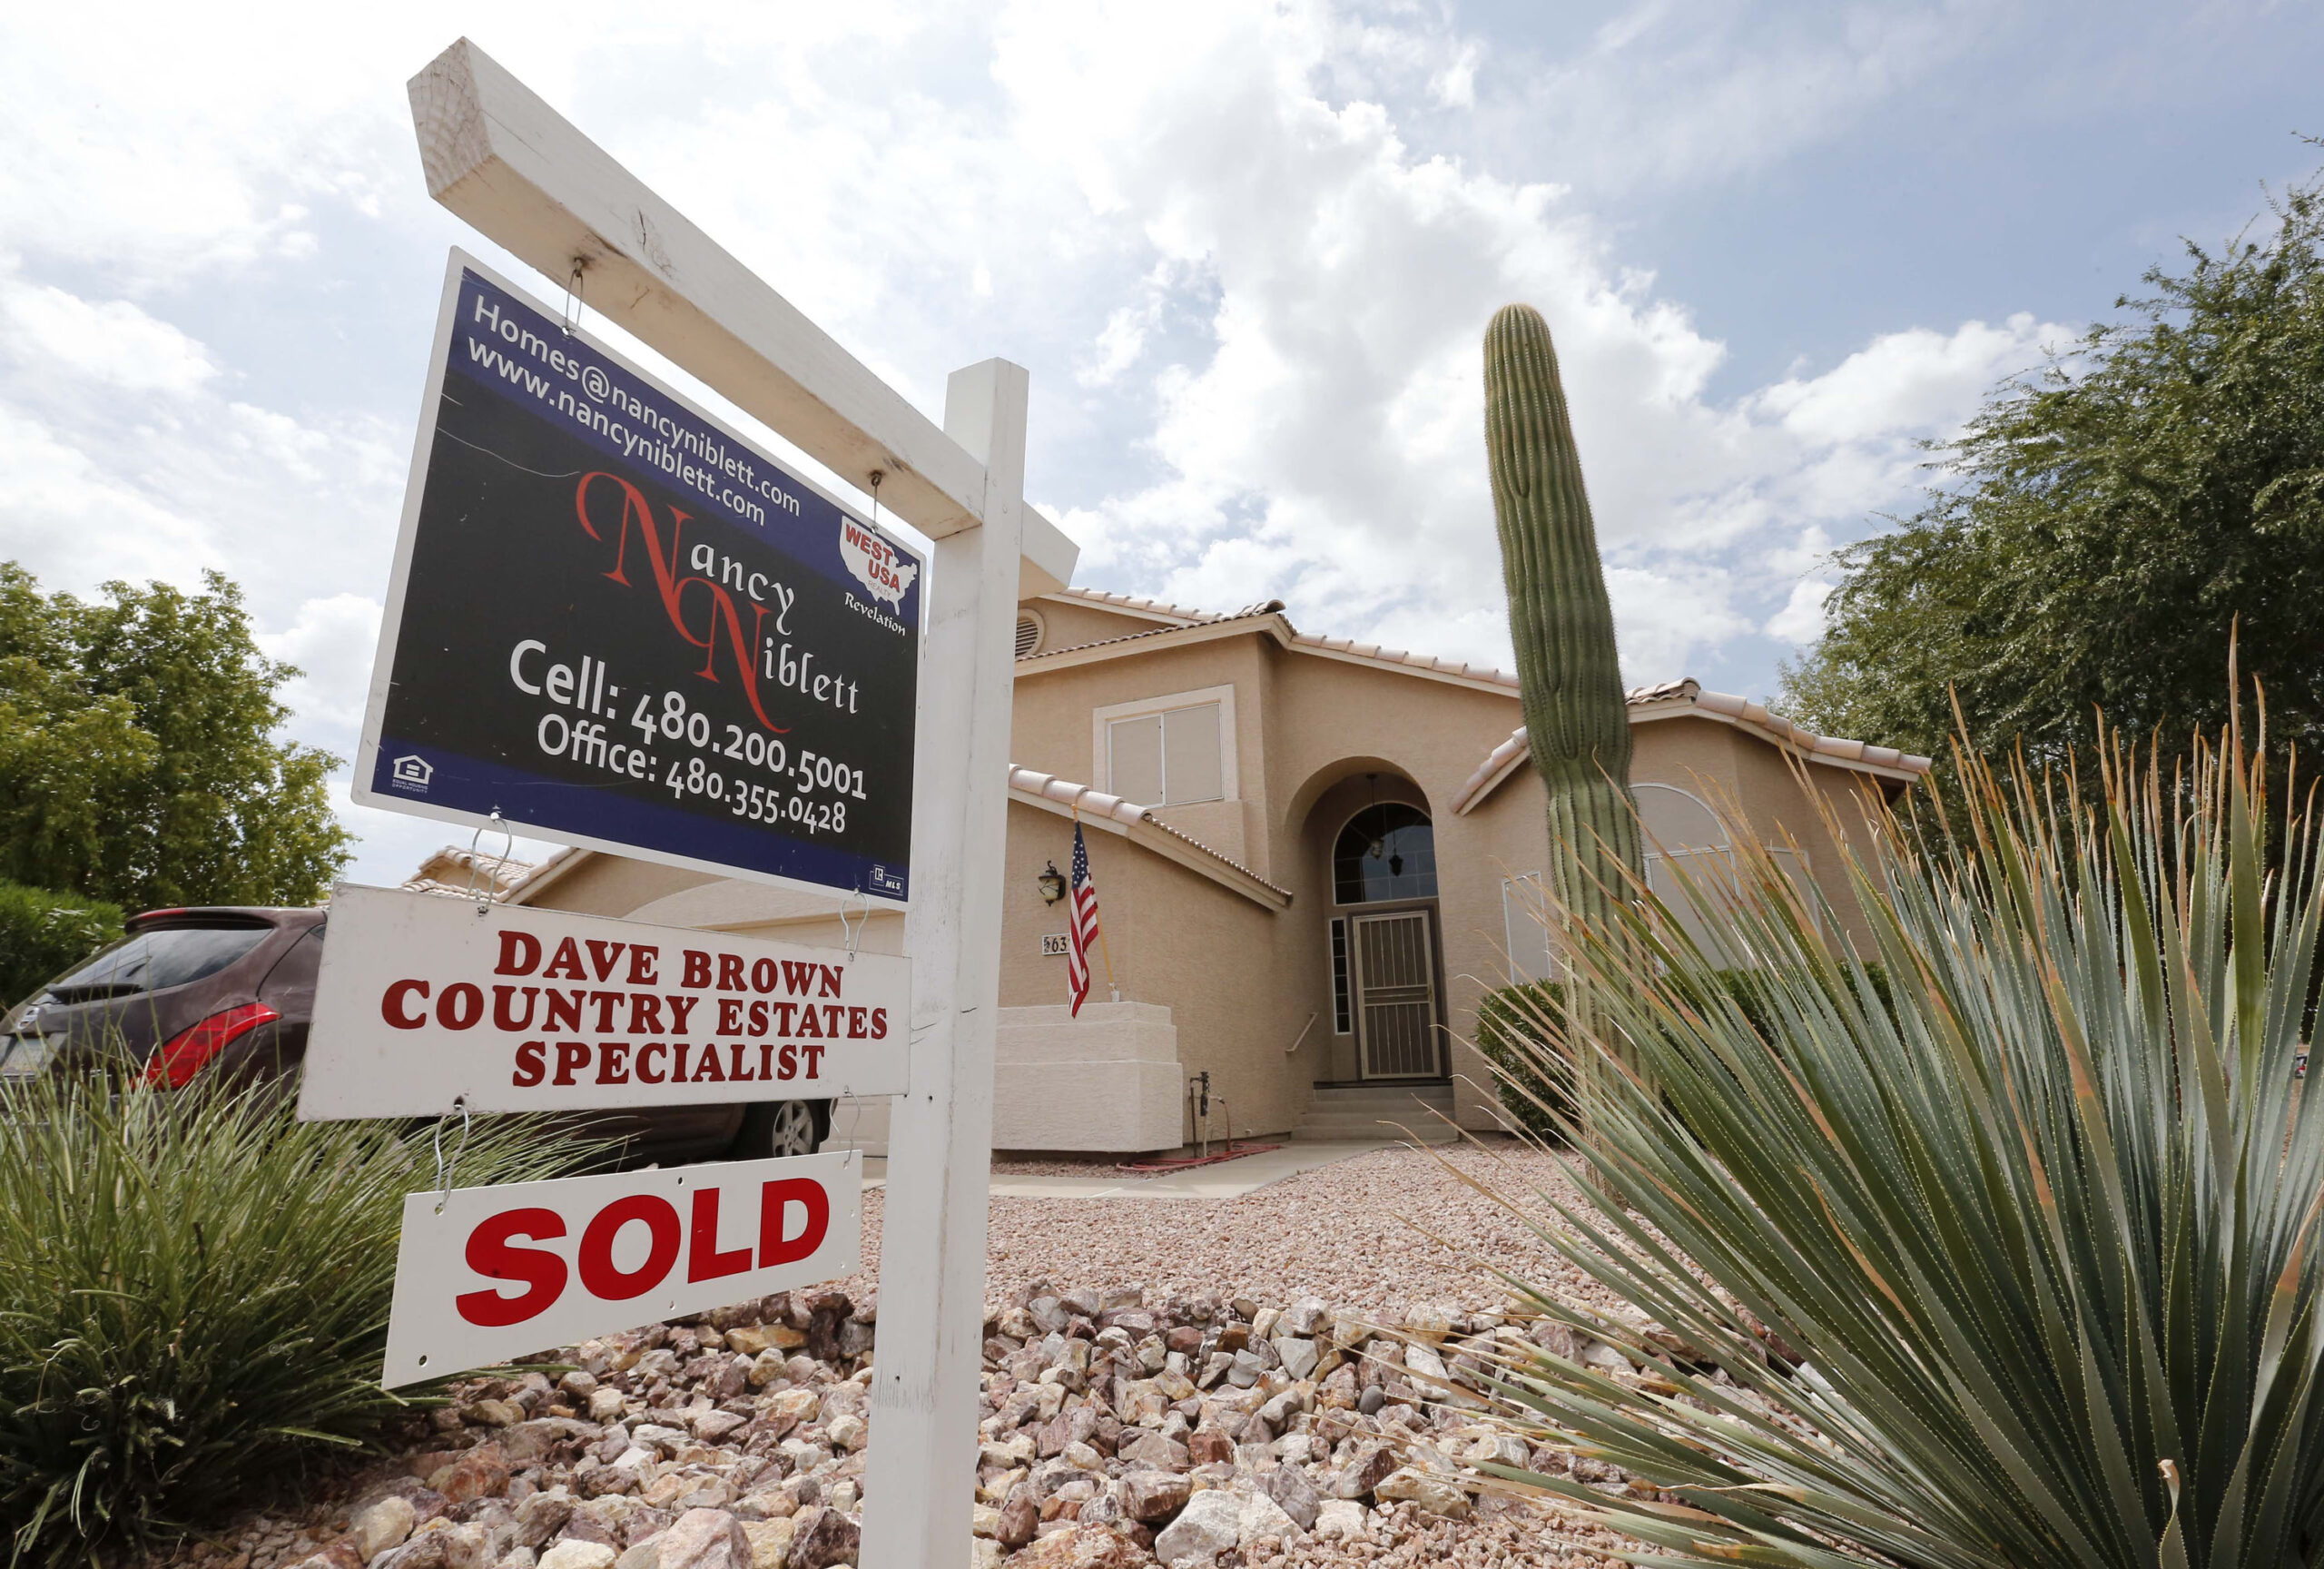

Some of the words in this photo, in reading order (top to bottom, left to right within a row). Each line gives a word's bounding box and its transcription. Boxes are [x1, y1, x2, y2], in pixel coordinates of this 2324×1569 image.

[468, 336, 765, 527] www.nancyniblett.com
[473, 294, 800, 517] Homes@nancyniblett.com
[576, 471, 795, 647] Nancy
[845, 523, 894, 567] WEST
[868, 558, 901, 593] USA
[844, 592, 906, 636] Revelation
[867, 580, 891, 597] REALTY
[673, 577, 860, 734] Niblett
[509, 638, 619, 720] Cell:
[631, 691, 867, 800] 480.200.5001
[537, 713, 657, 781] Office:
[665, 757, 847, 834] 480.355.0428
[885, 880, 901, 890] MLS
[494, 930, 659, 985] DAVE
[681, 949, 843, 999] BROWN
[381, 980, 698, 1035] COUNTRY
[716, 999, 887, 1040] ESTATES
[512, 1041, 824, 1087] SPECIALIST
[456, 1178, 830, 1327] SOLD
